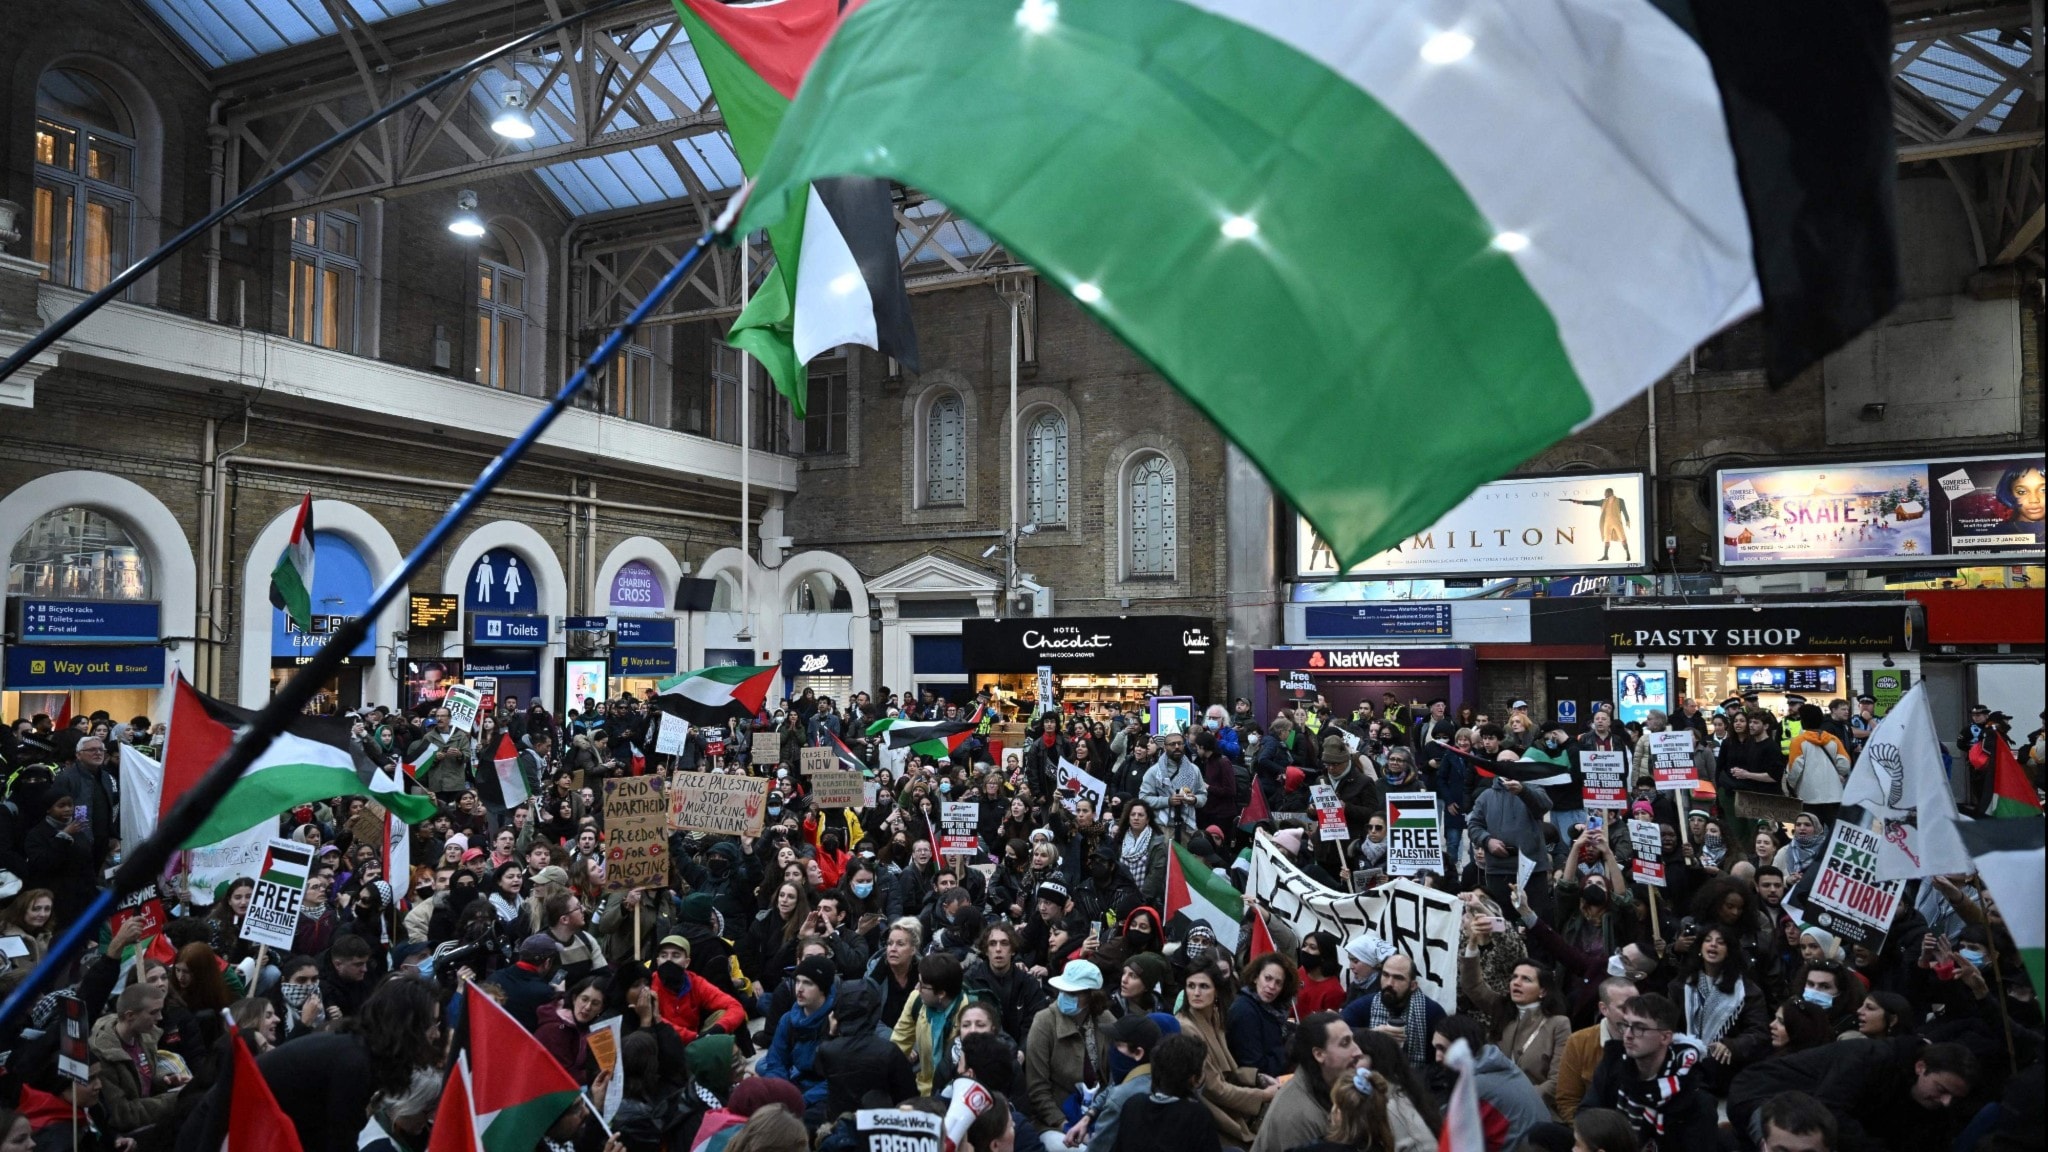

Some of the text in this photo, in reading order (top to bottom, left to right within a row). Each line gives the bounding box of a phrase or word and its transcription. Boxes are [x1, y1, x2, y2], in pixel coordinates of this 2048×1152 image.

[1942, 478, 1971, 486] SOMERSET
[1783, 498, 1858, 525] SKATE
[618, 577, 651, 589] CHARING
[617, 587, 651, 602] CROSS
[48, 605, 94, 614] Bicycle racks
[49, 615, 74, 624] Toilets
[48, 625, 78, 634] First aid
[506, 623, 539, 637] Toilets
[1610, 628, 1801, 647] The PASTY SHOP
[1808, 635, 1848, 645] Handmade
[1858, 634, 1893, 645] Cornwall
[630, 657, 654, 667] Way out
[800, 654, 829, 673] Boots
[1329, 651, 1400, 667] NatWest
[53, 661, 148, 676] Way out Strand
[1290, 671, 1310, 681] Free
[443, 700, 476, 719] FREE
[807, 759, 831, 770] NOW
[1654, 759, 1694, 769] STATE TERROR
[1656, 753, 1669, 761] END
[618, 781, 649, 798] END
[676, 775, 766, 795] FREE PALESTINE
[1601, 780, 1624, 788] TERROR
[700, 791, 728, 805] STOP
[606, 798, 666, 818] APARTHEID
[685, 801, 745, 819] MURDERING
[677, 812, 750, 832] PALESTINIANS
[942, 821, 955, 829] STOP
[955, 821, 964, 829] THE
[609, 827, 666, 847] FREEDOM
[1390, 829, 1440, 849] FREE
[1838, 827, 1860, 848] FREE
[624, 846, 646, 861] FOR
[1389, 849, 1441, 859] PALESTINE
[607, 858, 668, 882] PALESTINE
[251, 880, 302, 915] FREE
[1817, 868, 1895, 923] RETURN!
[248, 905, 297, 928] PALESTINE
[1832, 921, 1868, 940] SOLIDARITY
[1834, 917, 1866, 934] PALESTINE
[1831, 926, 1862, 943] CAMPAIGN
[873, 1114, 908, 1127] Socialist
